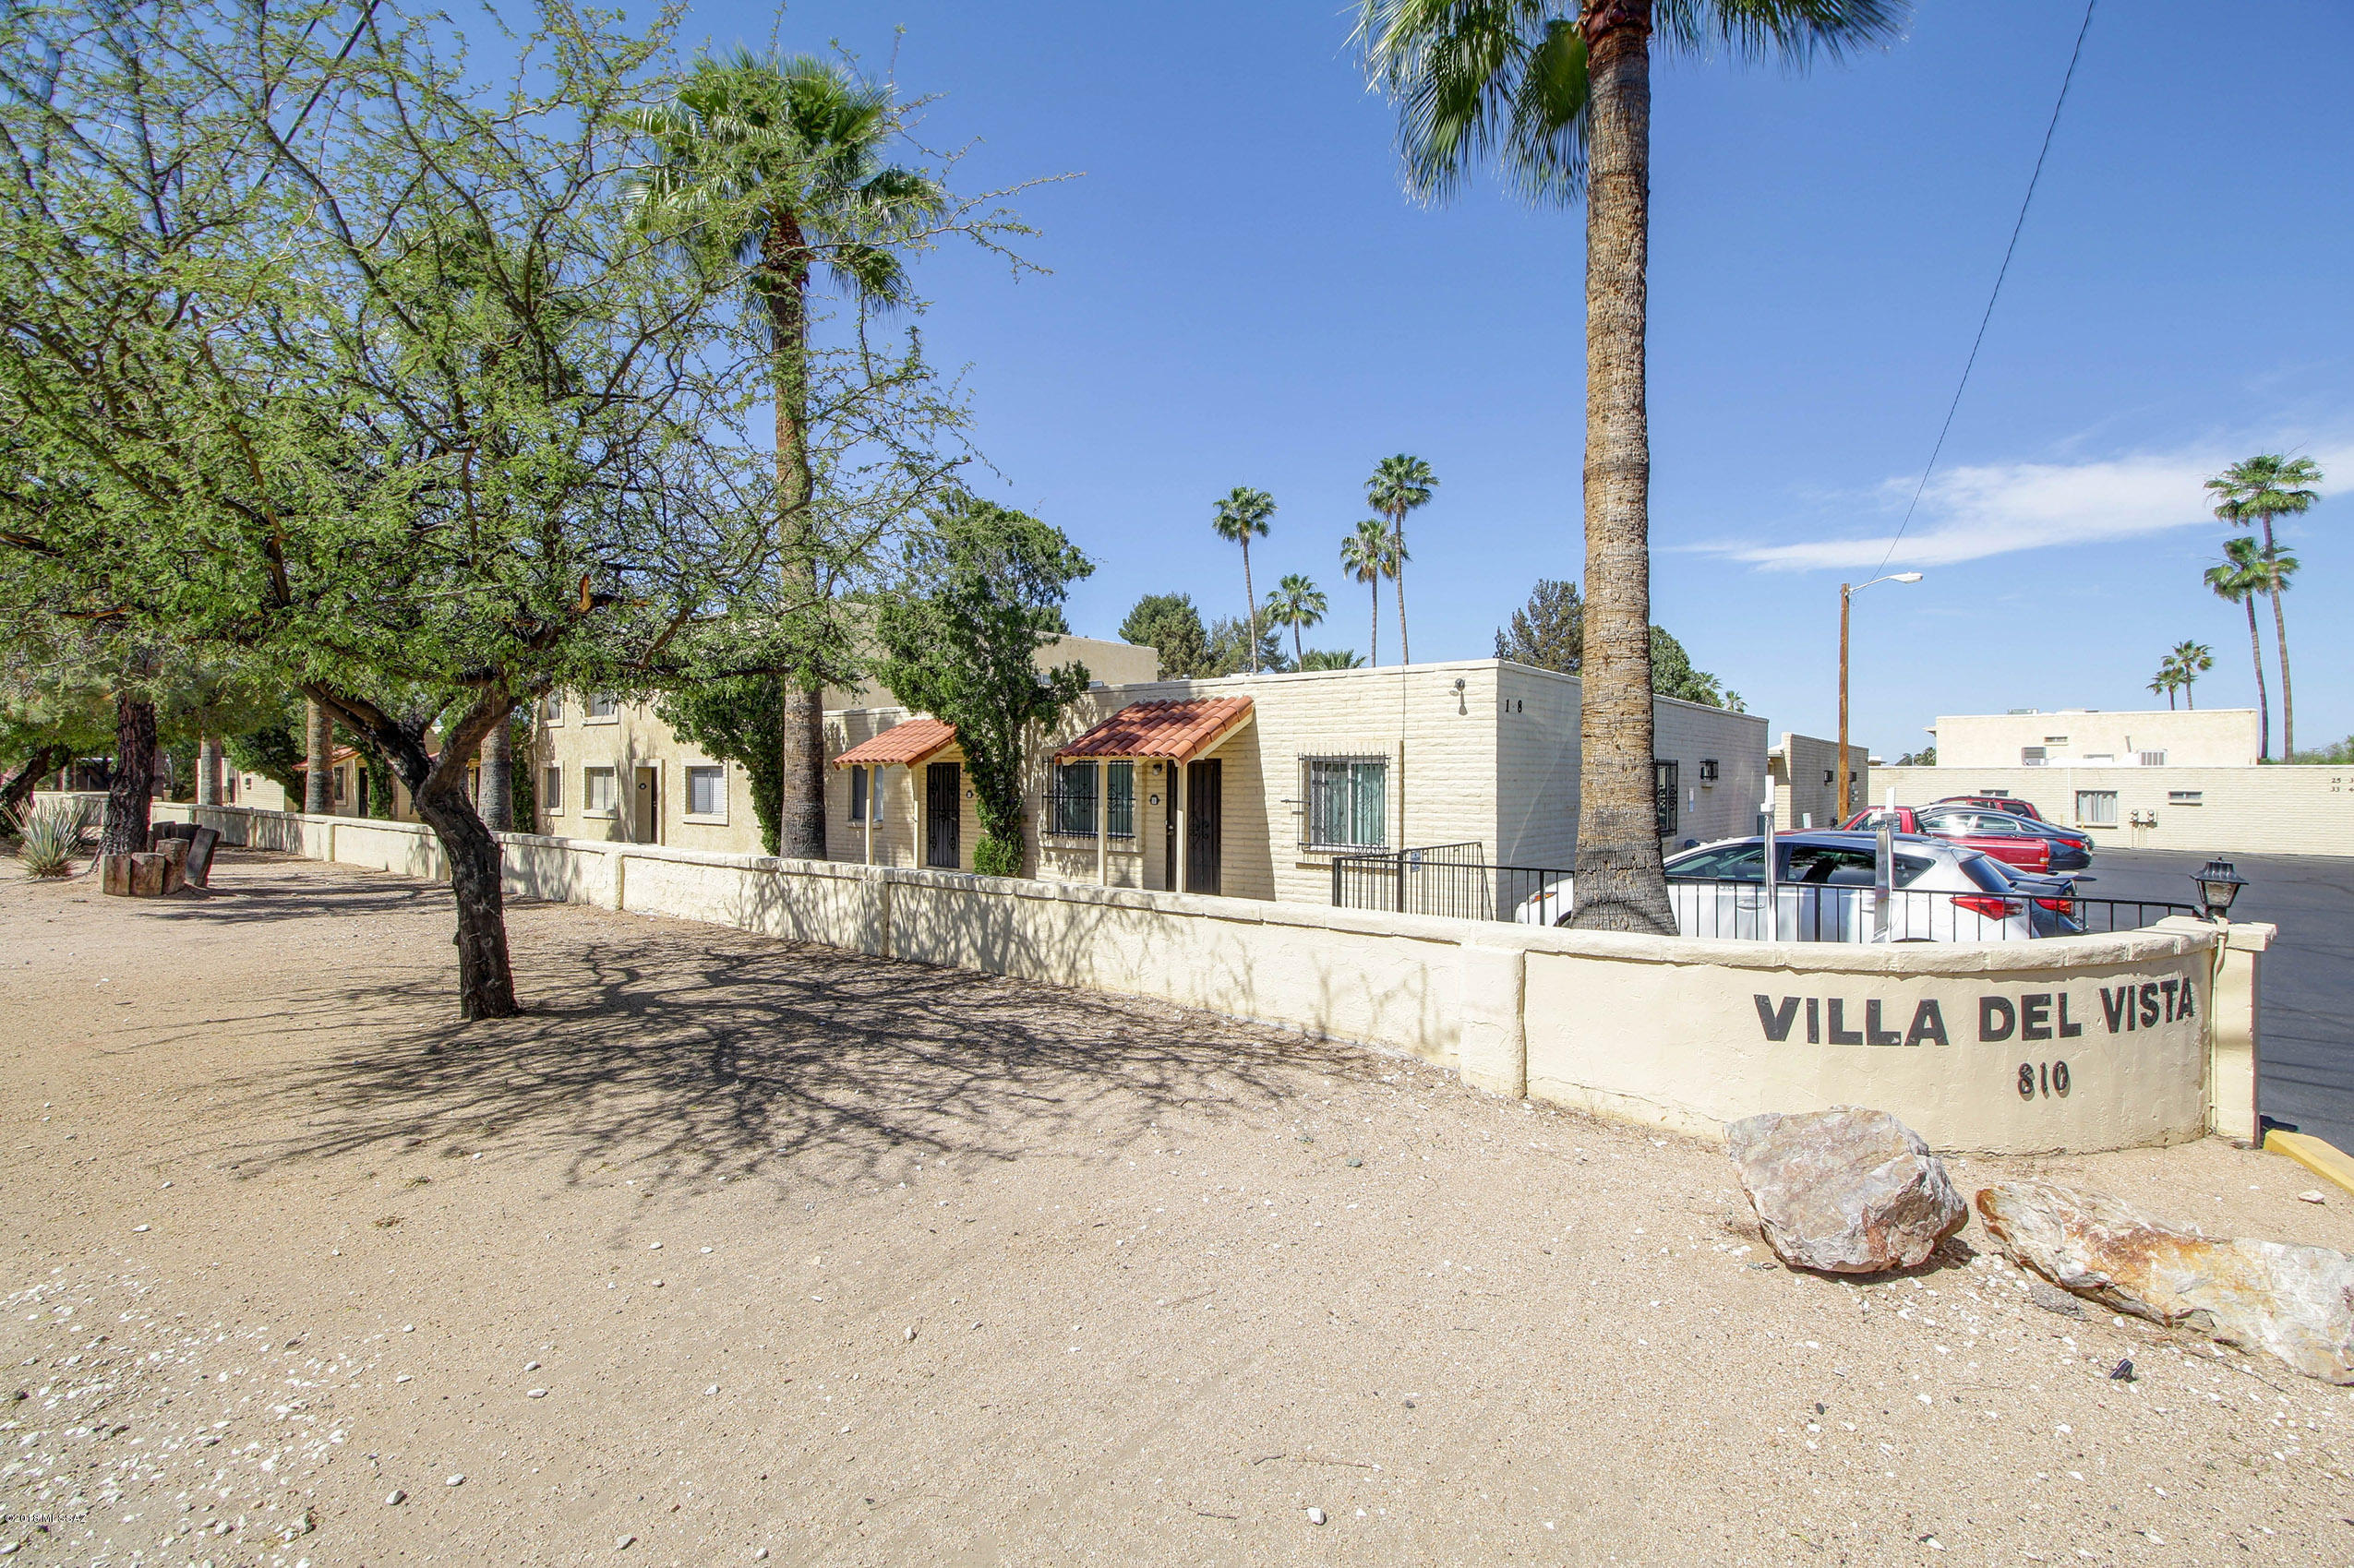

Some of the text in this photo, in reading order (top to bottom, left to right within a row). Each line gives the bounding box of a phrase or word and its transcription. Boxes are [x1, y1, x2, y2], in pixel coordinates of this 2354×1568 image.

[1754, 976, 2194, 1047] VILLA DEL VISTA
[2017, 1060, 2070, 1096] 810
